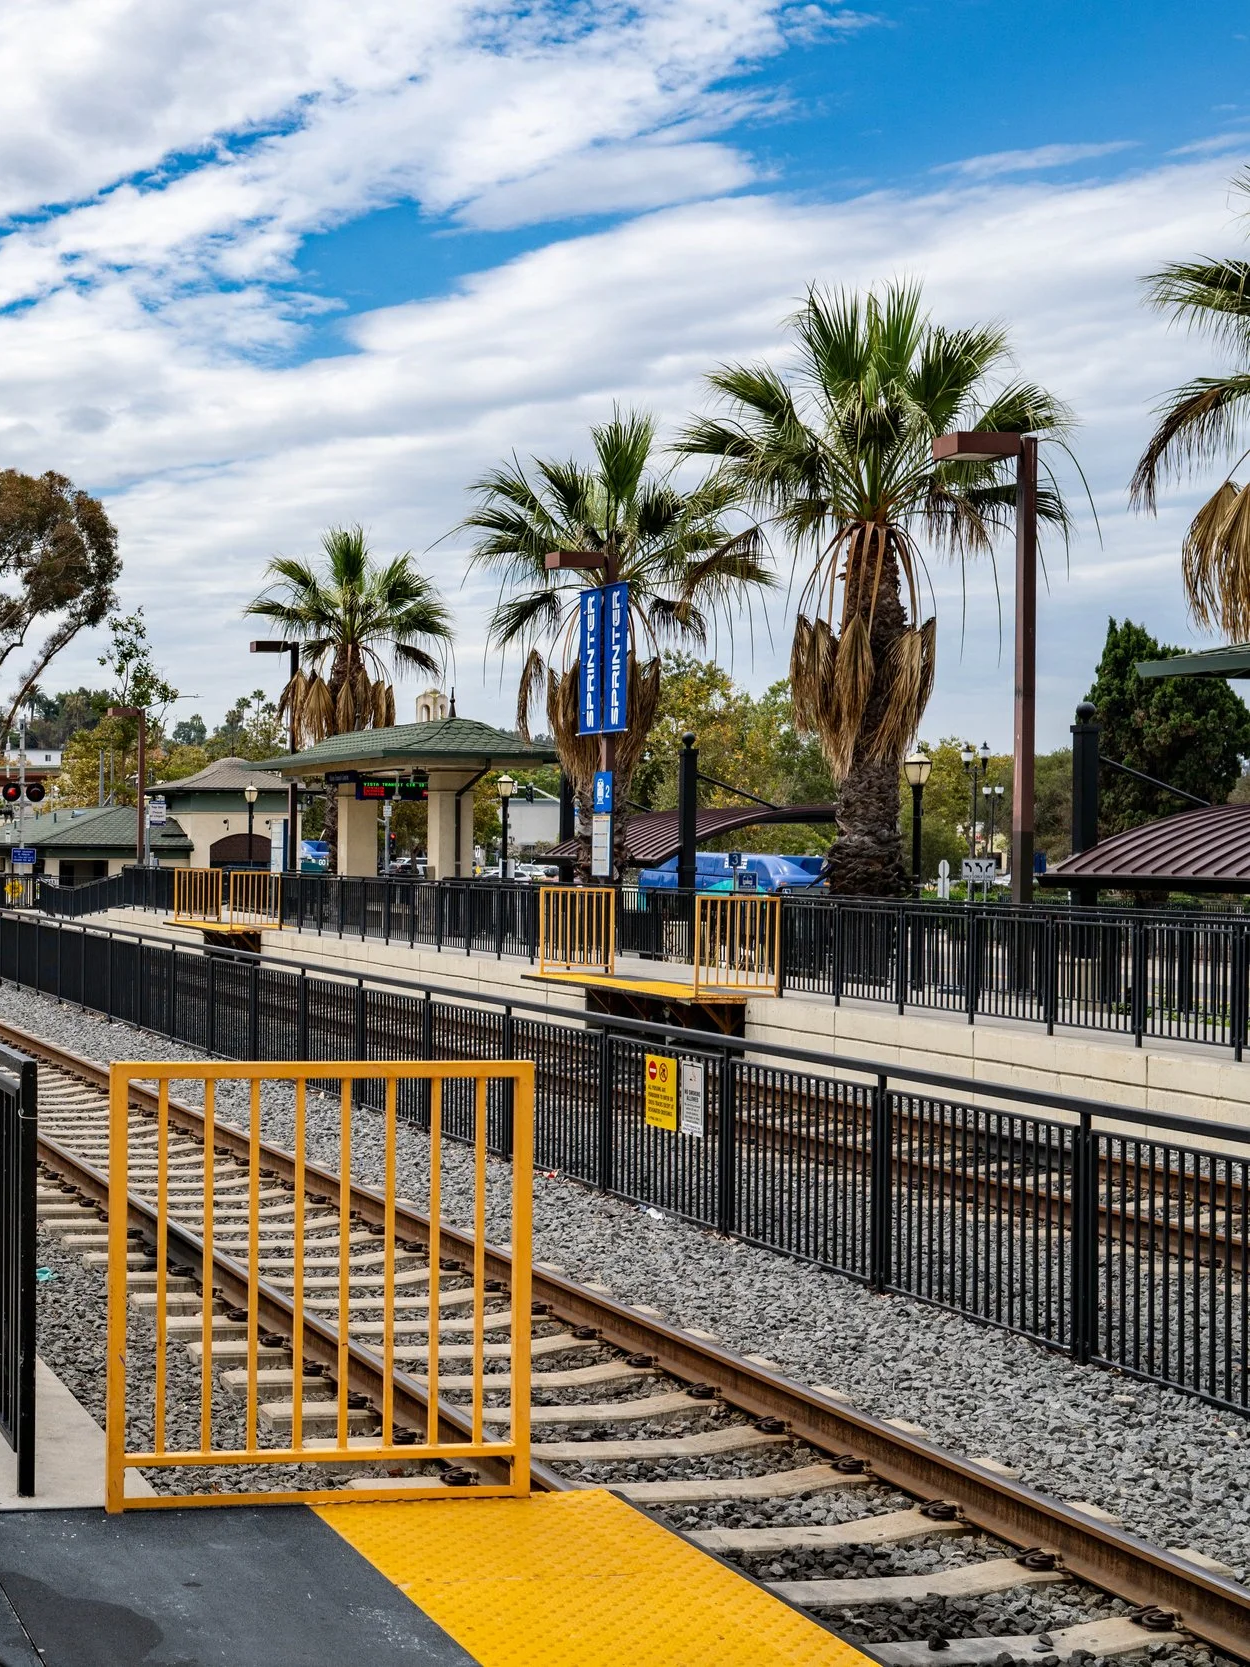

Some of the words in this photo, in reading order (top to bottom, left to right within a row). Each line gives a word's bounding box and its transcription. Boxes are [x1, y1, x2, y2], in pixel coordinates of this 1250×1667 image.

[586, 595, 596, 729] SPRINTER
[610, 590, 621, 726] SPRINTER
[605, 784, 610, 799] 2
[732, 854, 739, 865] 3
